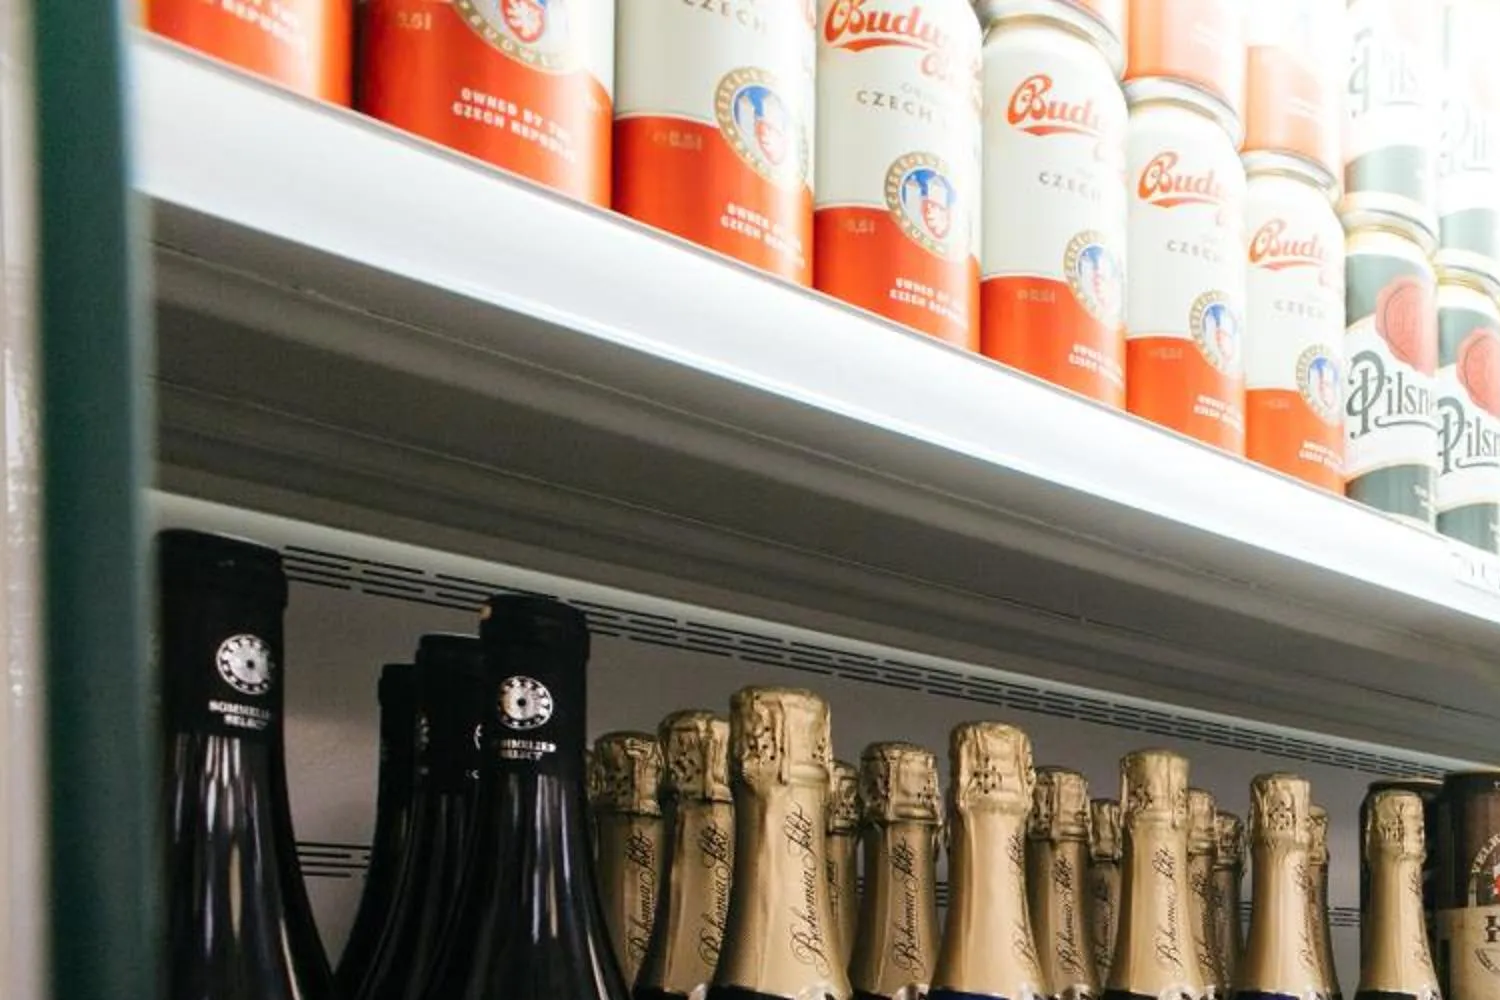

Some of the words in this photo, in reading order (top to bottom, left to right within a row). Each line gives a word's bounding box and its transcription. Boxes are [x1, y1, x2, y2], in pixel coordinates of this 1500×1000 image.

[452, 101, 505, 128] CZECH
[460, 87, 518, 116] OWNED
[856, 89, 932, 123] CZECH
